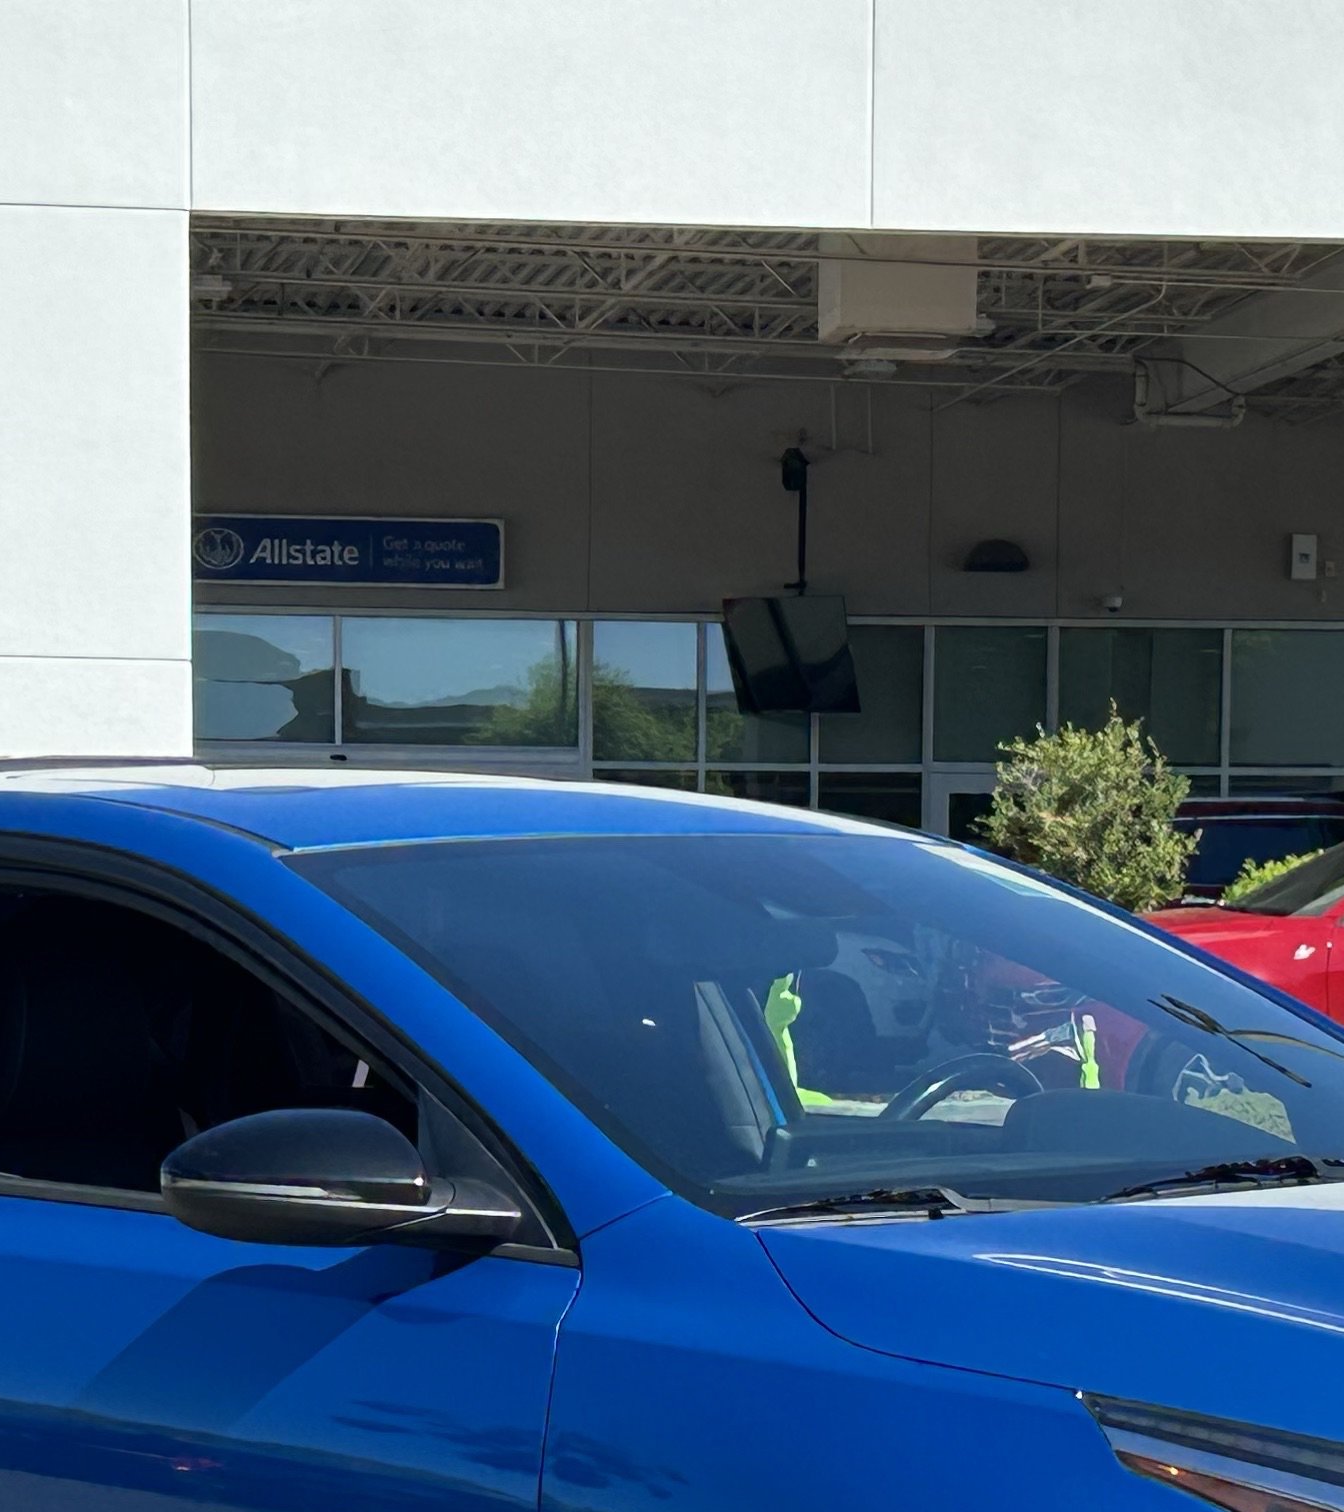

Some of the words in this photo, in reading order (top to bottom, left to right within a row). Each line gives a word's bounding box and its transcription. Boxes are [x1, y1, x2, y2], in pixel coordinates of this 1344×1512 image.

[249, 538, 360, 565] Allstate
[383, 535, 408, 551] Get
[424, 539, 466, 553] quote
[425, 558, 451, 571] you
